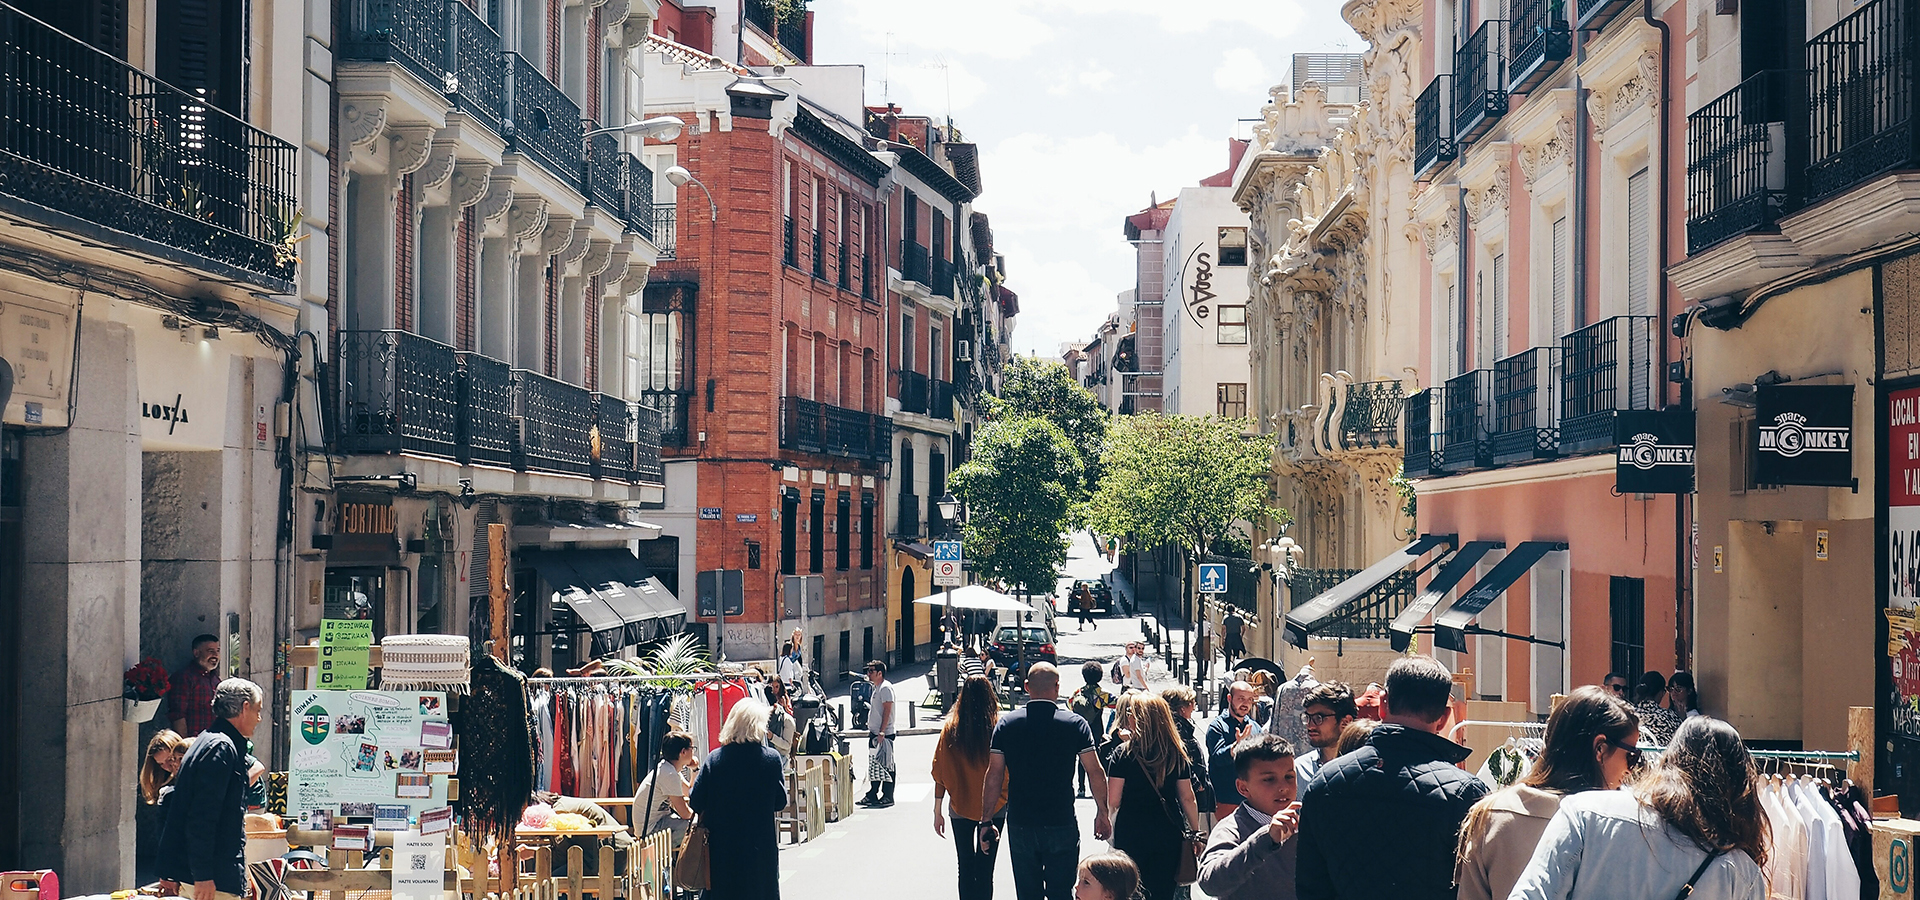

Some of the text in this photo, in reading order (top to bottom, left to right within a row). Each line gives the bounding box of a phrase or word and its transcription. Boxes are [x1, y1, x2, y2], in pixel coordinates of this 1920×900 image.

[1774, 411, 1807, 426] space
[1891, 398, 1915, 426] LOCAL
[1631, 432, 1659, 444] space
[1908, 433, 1919, 460] EN
[1904, 469, 1910, 495] Y
[342, 503, 395, 534] FORTINO
[460, 551, 466, 582] 2
[1891, 530, 1904, 597] 91
[294, 693, 318, 715] IDIWAKA
